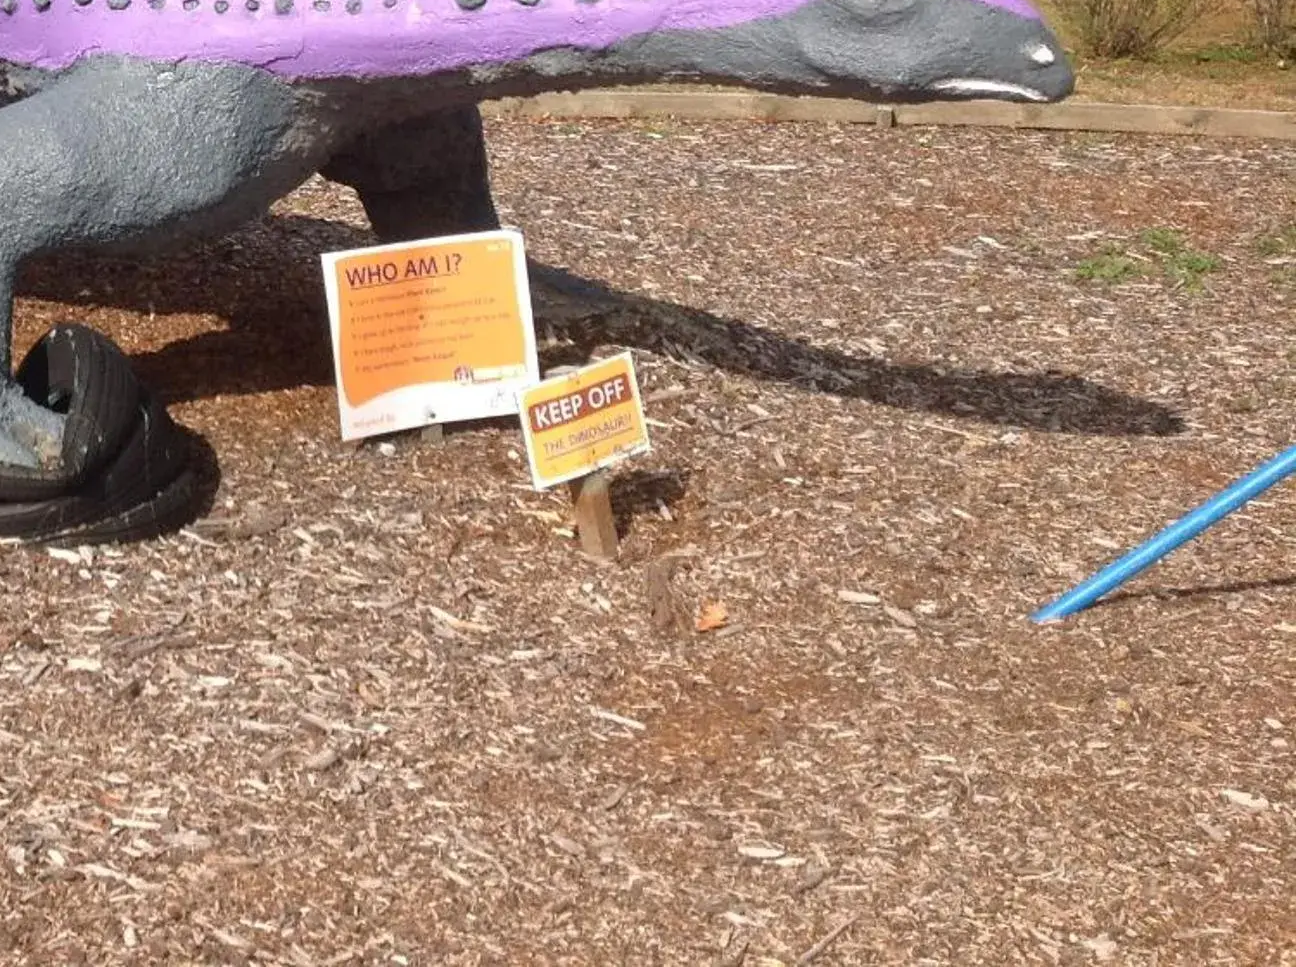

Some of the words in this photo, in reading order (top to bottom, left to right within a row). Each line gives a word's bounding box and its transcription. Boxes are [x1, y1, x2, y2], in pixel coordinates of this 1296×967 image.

[345, 262, 399, 287] WHO
[404, 256, 439, 278] AM
[444, 253, 463, 273] I?
[534, 393, 584, 429] KEEP
[587, 377, 625, 409] OFF
[543, 437, 565, 454] THE
